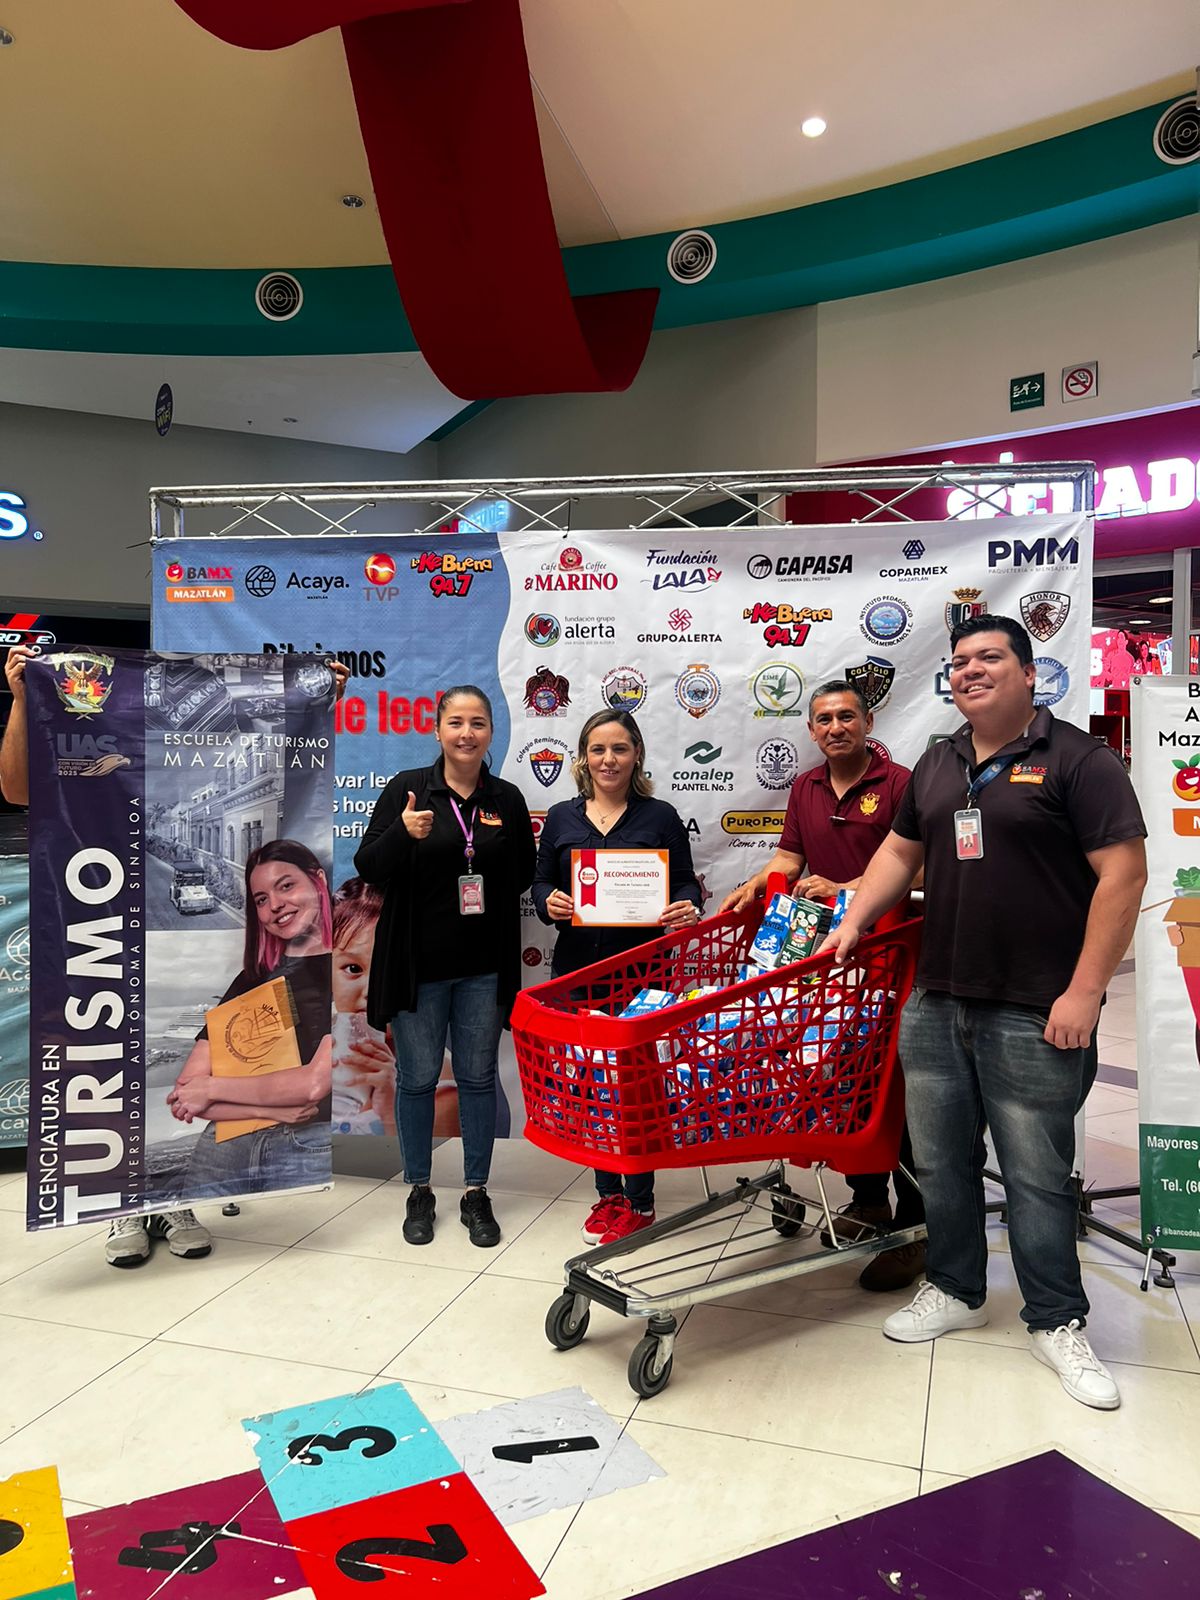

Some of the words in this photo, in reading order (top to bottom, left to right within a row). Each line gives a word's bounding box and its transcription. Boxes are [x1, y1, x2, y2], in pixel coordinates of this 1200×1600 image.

[646, 549, 718, 567] Fundación
[988, 538, 1079, 567] PMM
[187, 567, 233, 579] BAMX
[585, 562, 607, 572] Coffee
[775, 554, 852, 575] CAPASA
[879, 566, 948, 578] COPARMEX
[287, 572, 350, 593] Acaya.
[430, 574, 473, 598] 94.7
[535, 572, 618, 591] MARINO
[652, 569, 707, 591] LALA
[173, 588, 227, 599] MAZATLÁN
[363, 587, 400, 602] TVP
[1029, 592, 1062, 602] HONOR
[859, 596, 882, 620] INSTITUTO
[596, 615, 615, 623] grupo
[565, 623, 615, 639] alerta
[764, 623, 811, 648] 94.7
[850, 664, 889, 676] COLEGIO
[57, 733, 119, 758] UAS
[163, 733, 234, 746] ESCUELA
[240, 734, 259, 747] DE
[264, 735, 330, 749] TURISMO
[162, 749, 327, 770] MAZATLÁN
[673, 768, 734, 783] conalep
[671, 783, 709, 792] PLANTEL
[711, 783, 727, 792] No.
[728, 783, 734, 791] 3
[726, 816, 761, 828] PURO
[128, 797, 141, 889] SINALOA
[129, 906, 141, 928] DE
[127, 944, 141, 1064] AUTÓNOMA
[63, 847, 125, 1226] TURISMO
[42, 1043, 61, 1071] EN
[1147, 1135, 1199, 1151] Mayores
[38, 1078, 61, 1230] LICENCIATURA
[1160, 1178, 1183, 1193] Tel.
[287, 1425, 398, 1468] 3
[491, 1435, 601, 1465] 1
[117, 1520, 242, 1575] 4
[335, 1523, 469, 1583] 2
